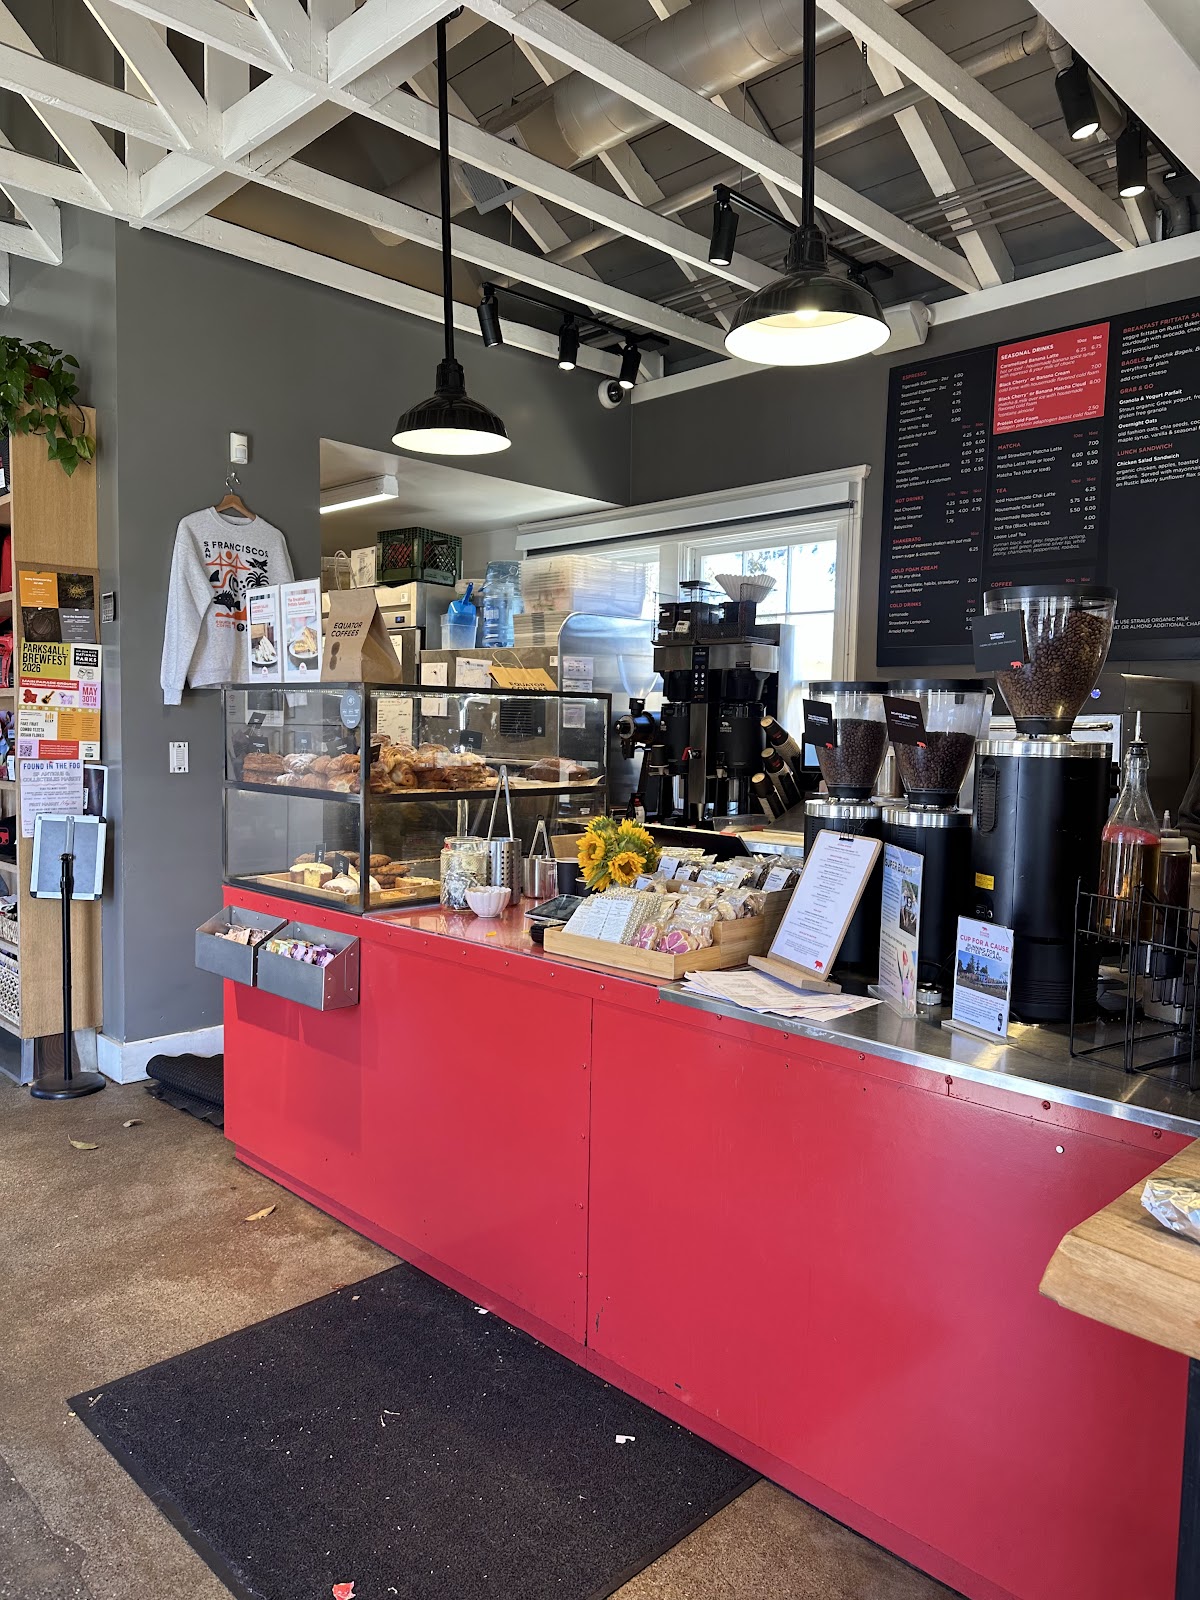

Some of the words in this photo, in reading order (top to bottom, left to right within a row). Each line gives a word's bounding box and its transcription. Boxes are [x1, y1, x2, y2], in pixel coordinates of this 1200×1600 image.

[1123, 322, 1158, 333] BREAKFAST
[1160, 315, 1189, 325] FRITTATA
[1122, 338, 1149, 347] sourdough
[1001, 350, 1030, 360] SEASONAL
[1032, 345, 1053, 353] DRINKS
[1133, 344, 1159, 353] prosciutto
[1001, 360, 1028, 369] Caramelized
[1122, 358, 1145, 366] BAGELS
[1121, 365, 1148, 374] everything
[903, 372, 927, 380] ESPRESSO
[1139, 444, 1172, 453] SANDWICH
[212, 541, 264, 557] FRANCISCO
[23, 643, 69, 655] PARKS4ALL:
[22, 653, 68, 665] BREWFEST
[22, 663, 41, 672] 2026
[82, 687, 97, 696] MAY
[972, 937, 983, 946] FOR
[990, 943, 1009, 953] CAUSE
